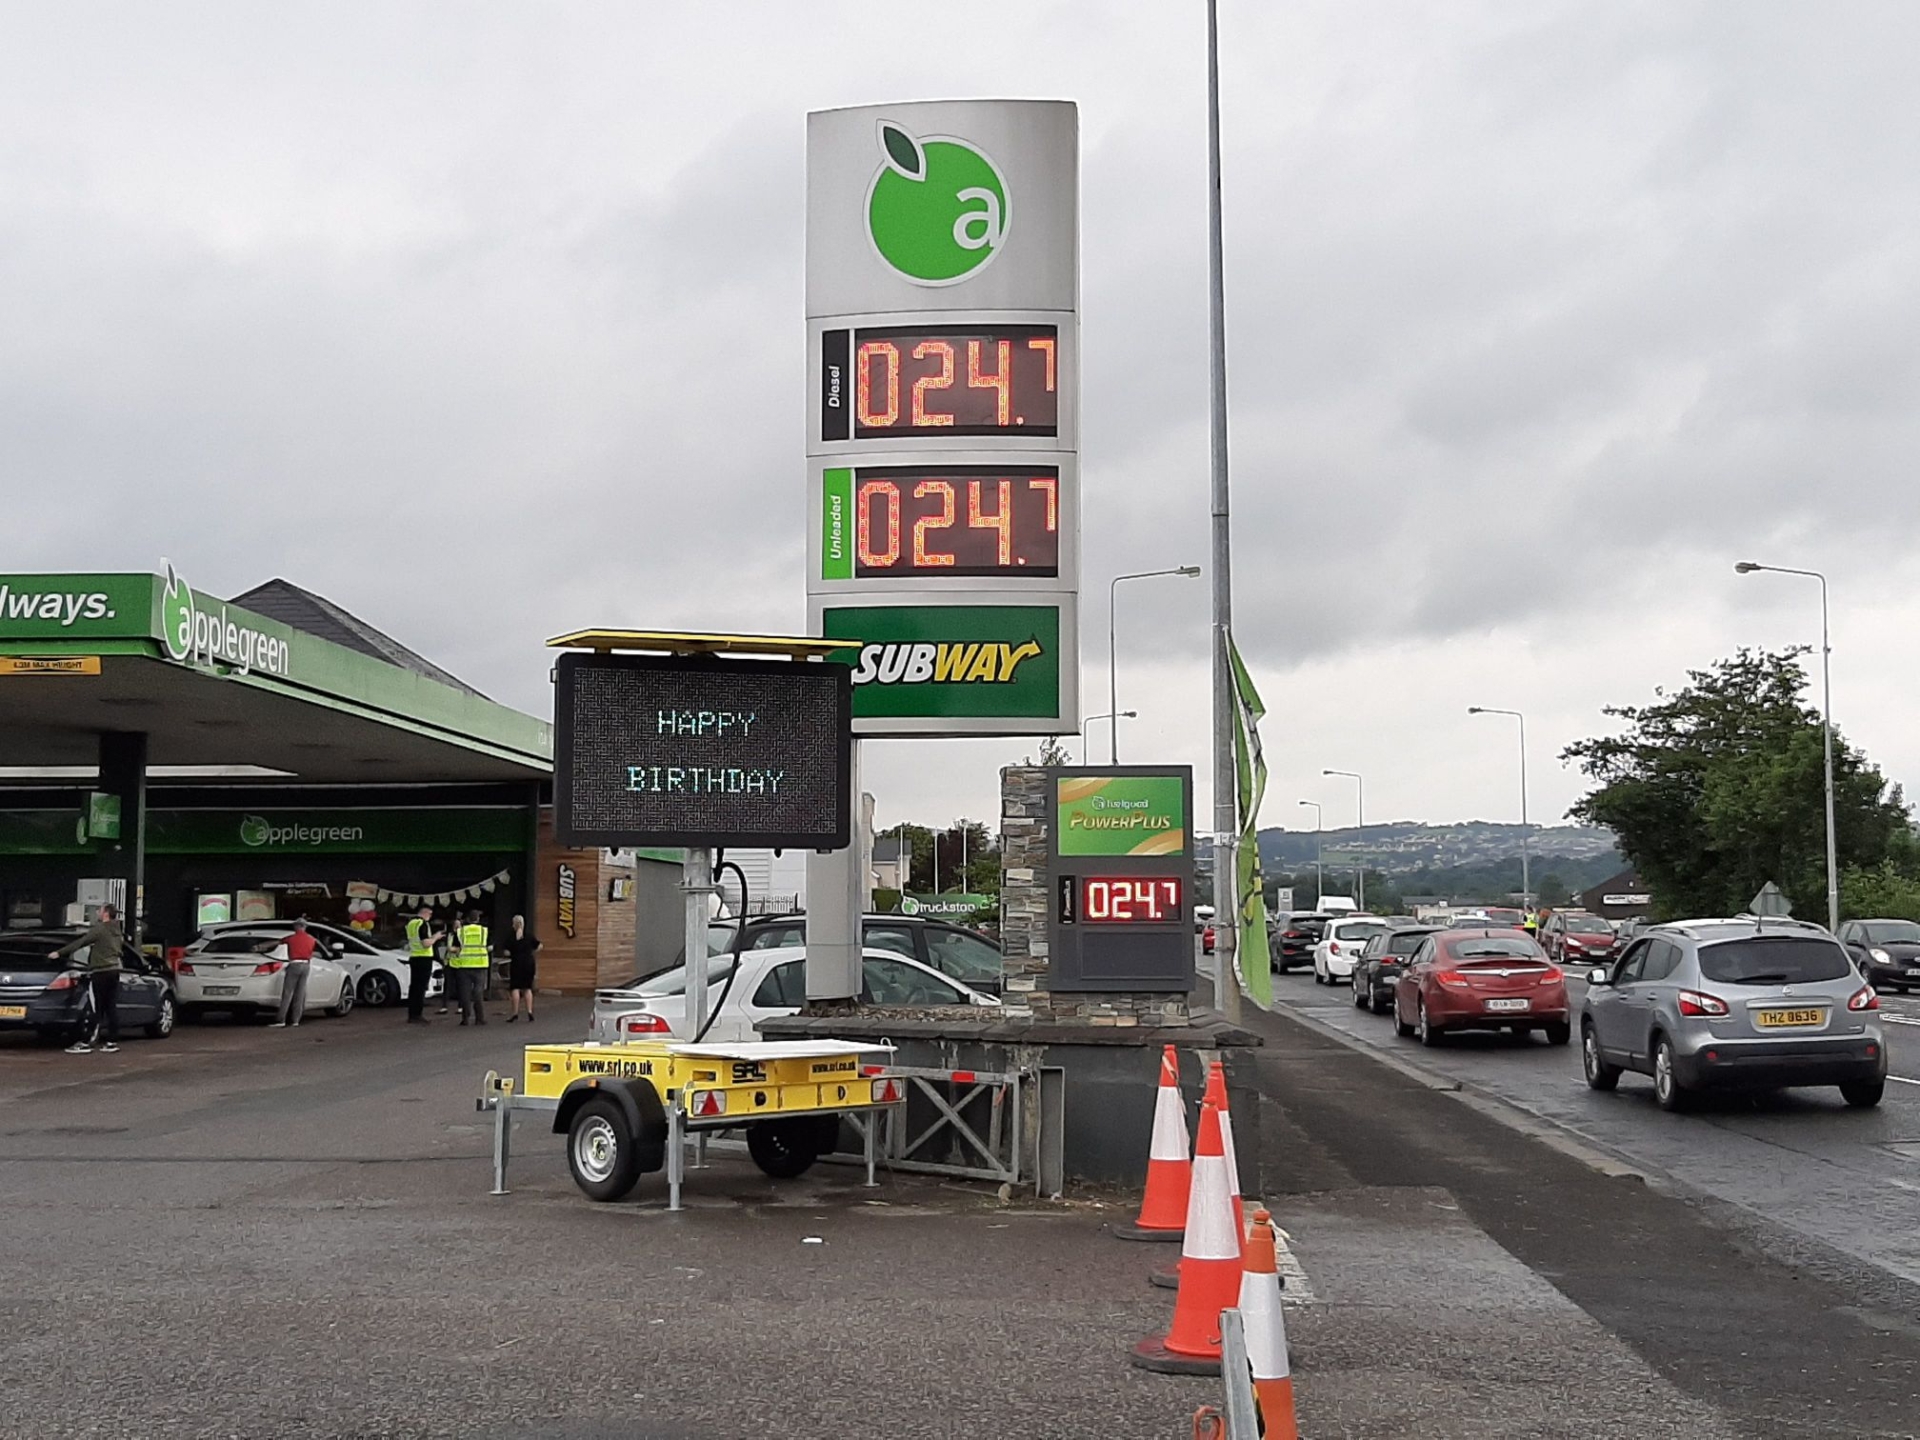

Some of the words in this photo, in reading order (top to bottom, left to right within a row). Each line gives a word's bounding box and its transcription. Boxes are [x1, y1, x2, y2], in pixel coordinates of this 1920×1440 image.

[828, 365, 840, 408] Diesel
[857, 338, 1055, 427] 024.7
[830, 495, 842, 559] Unleaded
[857, 479, 1056, 567] 024.7
[177, 605, 290, 676] applegreen
[851, 640, 1042, 686] SUBWAY
[657, 709, 755, 737] HAPPY
[625, 766, 785, 795] BIRTHDAY
[256, 823, 363, 845] applegreen
[558, 863, 575, 937] SUBWAY
[1088, 881, 1176, 919] 024.7
[579, 1058, 653, 1078] www.srl.co.uk
[732, 1060, 767, 1081] SRL
